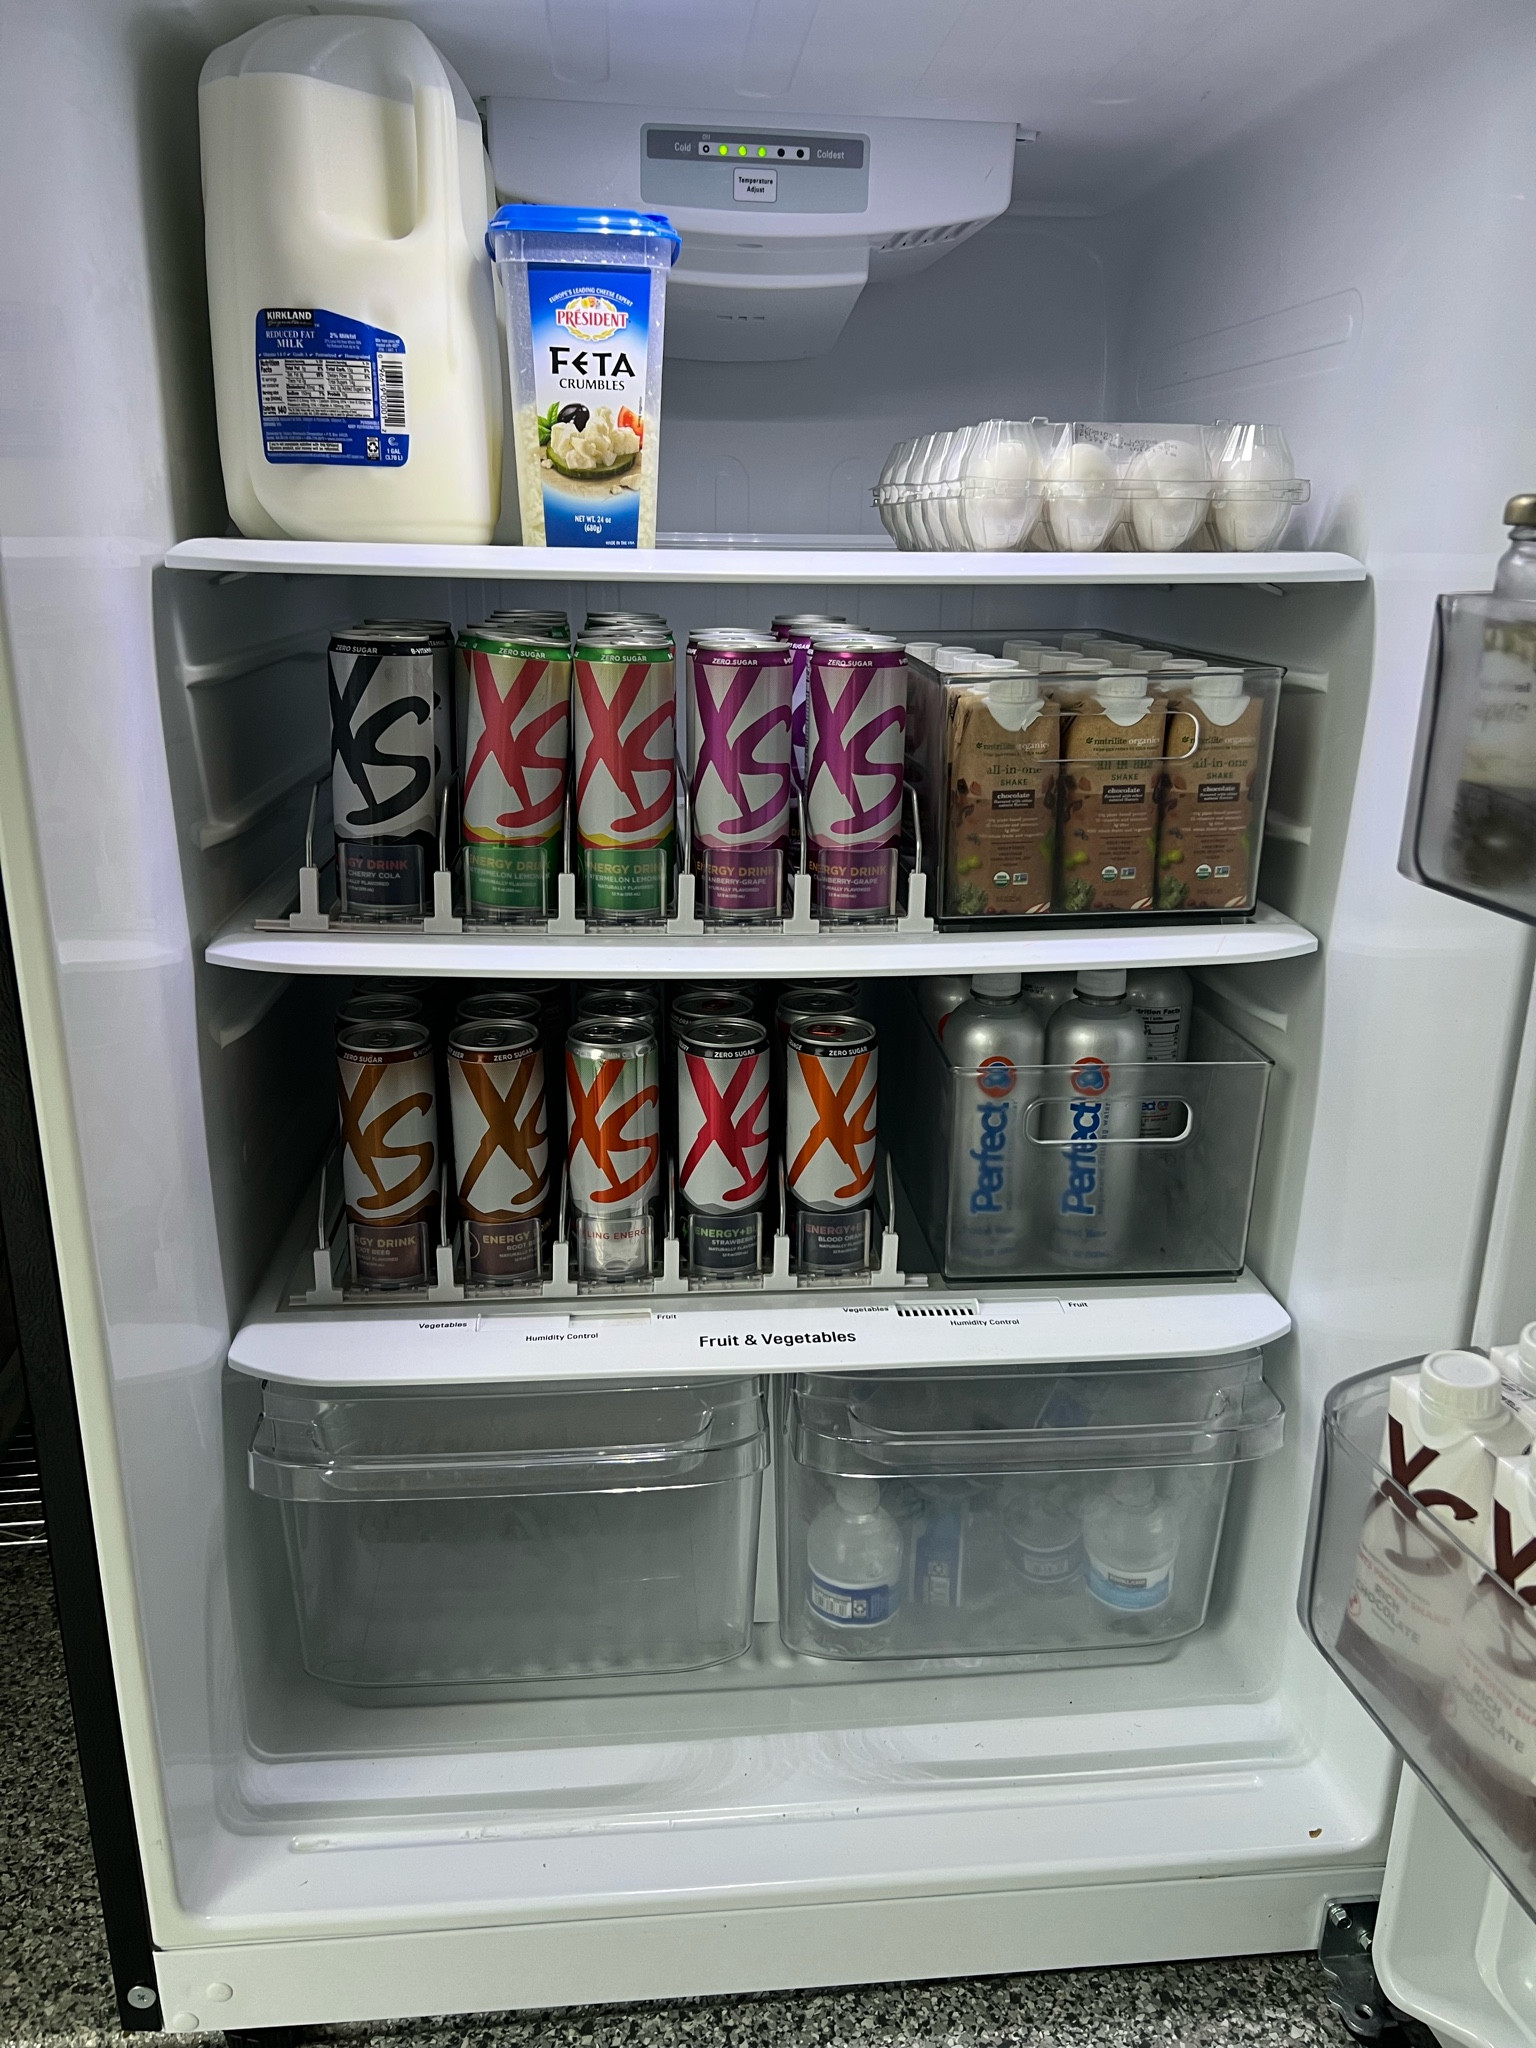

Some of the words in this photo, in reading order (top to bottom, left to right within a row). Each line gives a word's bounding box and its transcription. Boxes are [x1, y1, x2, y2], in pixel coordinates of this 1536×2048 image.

[674, 142, 691, 152] Cold
[816, 149, 844, 160] Coldest
[738, 176, 773, 185] Temperature
[746, 185, 765, 194] Adjust
[549, 289, 572, 303] EUROPE'S
[596, 288, 615, 297] CHEESE
[615, 292, 633, 307] EXPERT
[266, 311, 312, 320] KIRKLAND
[557, 309, 627, 328] PRÉSIDENT
[265, 331, 299, 339] REDUCED
[301, 331, 315, 339] FAT
[277, 338, 304, 348] MILK
[549, 346, 636, 378] FETA
[559, 378, 625, 391] CRUMBLES
[597, 515, 604, 523] 24
[584, 524, 602, 534] (680g)
[336, 644, 351, 652] ZERO
[352, 646, 378, 654] SUGAR
[498, 647, 519, 656] ZERO
[520, 649, 546, 658] SUGAR
[601, 654, 620, 662] ZERO
[712, 657, 731, 665] ZERO
[828, 659, 846, 667] ZERO
[986, 764, 1042, 775] all-in-one
[1000, 778, 1028, 786] SHAKE
[1111, 773, 1139, 781] SHAKE
[367, 858, 408, 870] DRINK
[588, 863, 630, 875] NERGY
[738, 865, 775, 877] DRINK
[850, 865, 887, 876] DRINK
[493, 1053, 513, 1062] ZERO
[513, 1047, 534, 1058] SUGAR
[734, 1048, 755, 1058] SUGAR
[828, 1048, 847, 1056] ZERO
[848, 1046, 868, 1056] SUGAR
[343, 1052, 358, 1061] ZERO
[1102, 1102, 1111, 1126] water
[970, 1101, 1009, 1216] Perfect
[1060, 1098, 1102, 1217] Perfect
[695, 1226, 757, 1238] ENERGY+B
[805, 1223, 862, 1235] ENERGY+B
[377, 1235, 416, 1248] DRINK
[482, 1231, 530, 1245] ENERGY
[711, 1234, 757, 1245] STRAWBERRY
[506, 1242, 526, 1251] ROOT
[843, 1305, 889, 1314] Vegetables
[656, 1312, 677, 1320] Fruit
[418, 1321, 468, 1330] Vegetables
[950, 1319, 987, 1327] Humidity
[988, 1318, 1020, 1326] Control
[525, 1333, 565, 1342] Humidity
[566, 1332, 599, 1340] Control
[699, 1333, 740, 1348] Fruit
[744, 1333, 758, 1346] &
[761, 1329, 857, 1346] Vegetables
[1374, 1583, 1401, 1614] RICH
